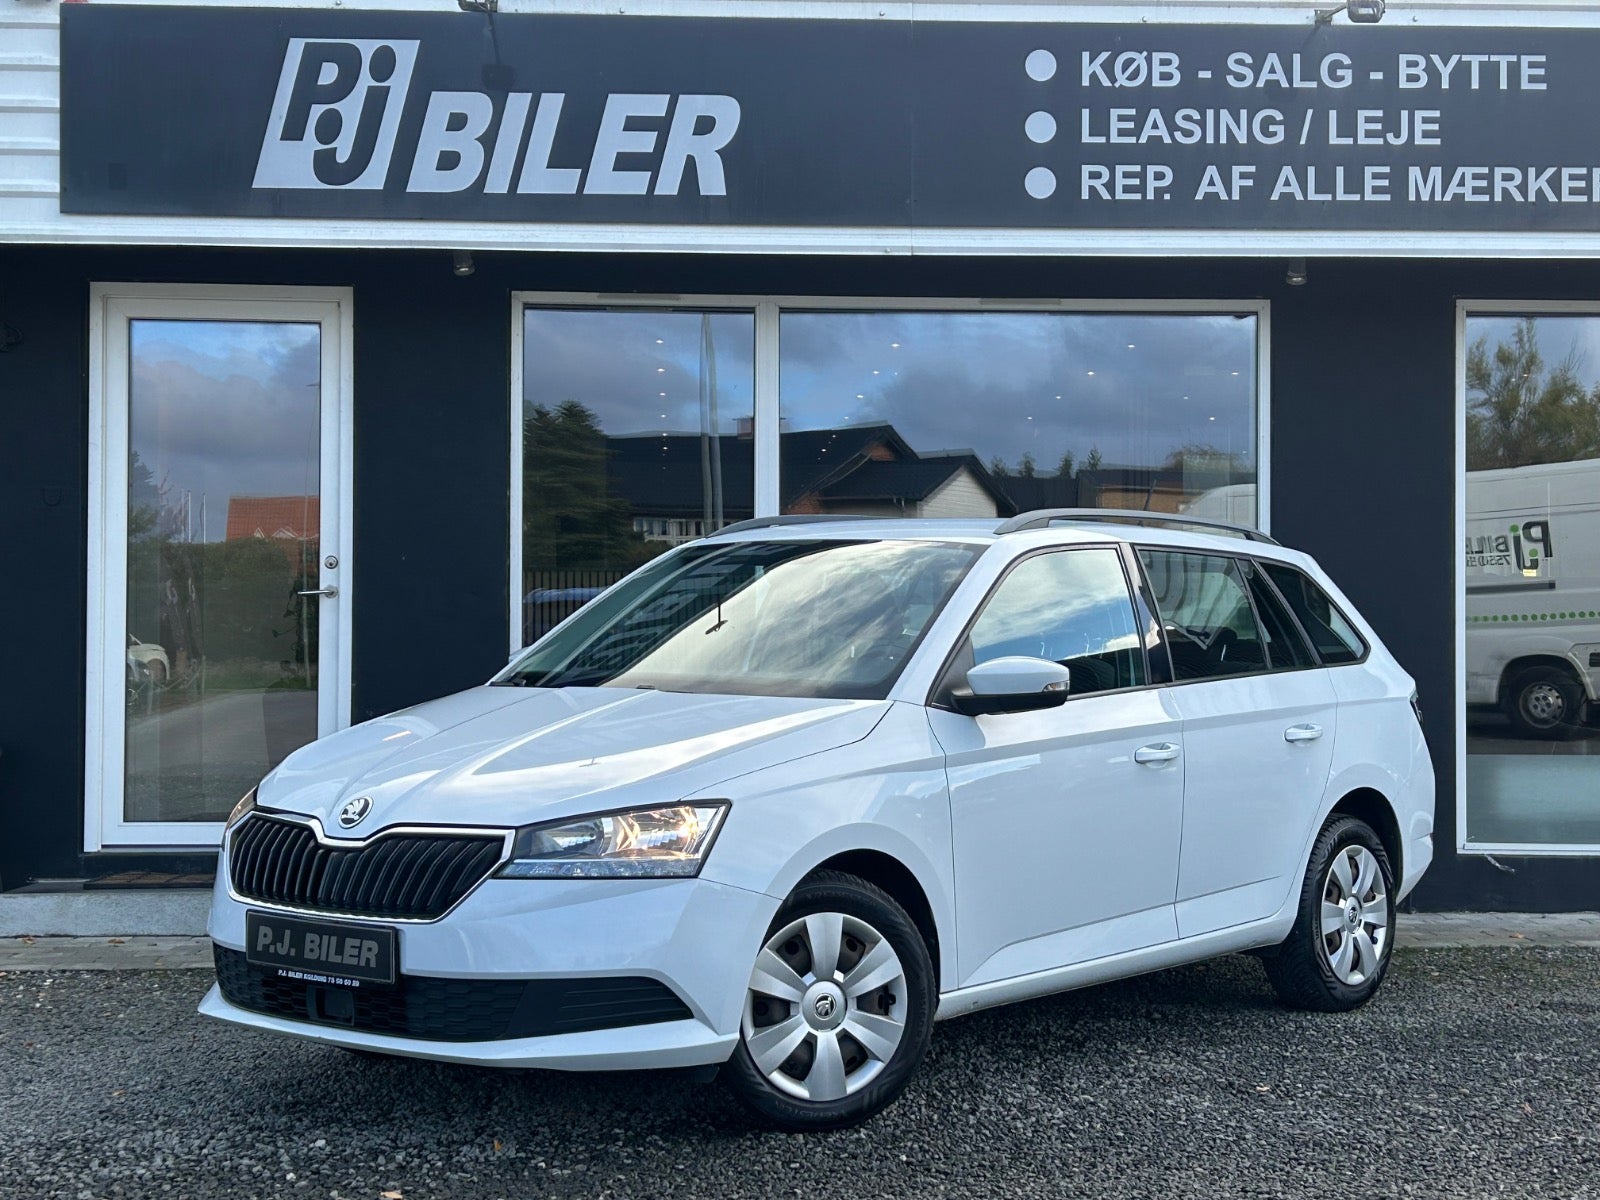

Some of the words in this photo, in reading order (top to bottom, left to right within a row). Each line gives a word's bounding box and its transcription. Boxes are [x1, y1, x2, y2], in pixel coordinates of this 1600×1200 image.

[1081, 50, 1181, 88] KØB
[1198, 70, 1212, 79] -
[1226, 52, 1353, 89] SALG
[1369, 71, 1384, 80] -
[1398, 54, 1548, 91] BYTTE
[406, 90, 741, 196] BILER
[1081, 108, 1286, 145] LEASING
[1299, 109, 1313, 145] /
[1328, 110, 1442, 146] LEJE
[1081, 164, 1172, 200] REP.
[1194, 165, 1258, 200] AF
[1270, 165, 1392, 201] ALLE
[256, 925, 296, 956] P.J.
[303, 932, 379, 968] BILER
[288, 970, 304, 979] BILER
